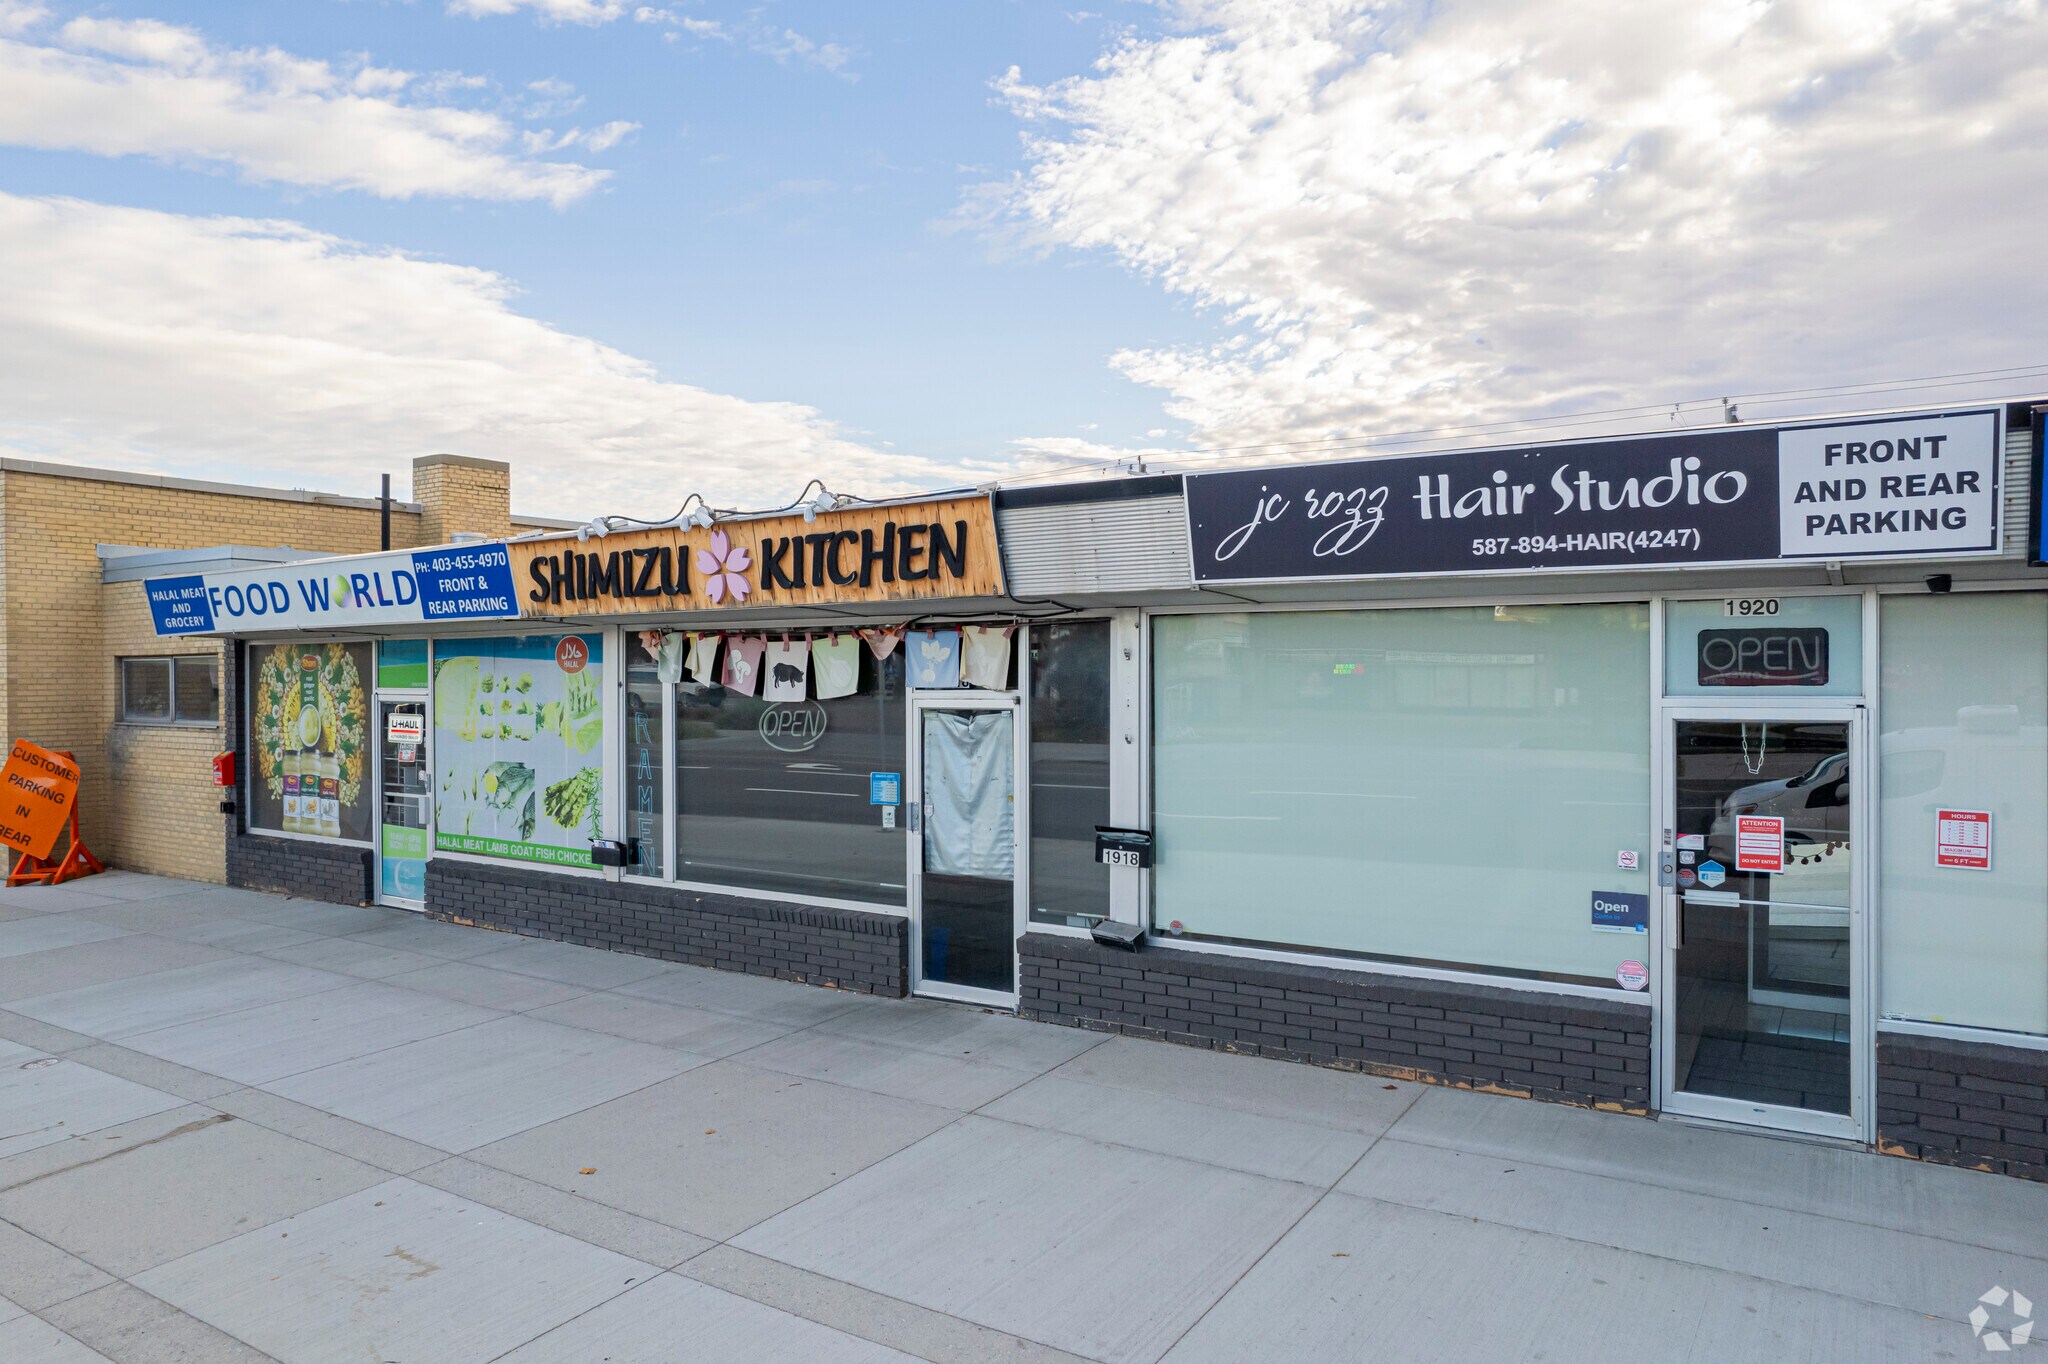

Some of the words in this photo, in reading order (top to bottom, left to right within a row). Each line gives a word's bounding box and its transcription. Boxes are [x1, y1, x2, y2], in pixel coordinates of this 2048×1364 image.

[1825, 435, 1947, 467] FRONT
[1413, 470, 1536, 519] Hair
[1551, 456, 1747, 515] Studio
[1794, 478, 1867, 504] AND
[1880, 471, 1981, 499] REAR
[1806, 506, 1967, 537] PARKING
[1472, 528, 1701, 555] 587-894-HAIR(4247)
[415, 561, 430, 573] PH:
[432, 551, 507, 572] 403-455-4970
[529, 545, 691, 603] SHIMIZU
[760, 520, 968, 590] KITCHEN
[152, 589, 179, 601] HALAL
[181, 587, 204, 599] MEAT
[438, 576, 474, 593] FRONT
[479, 575, 489, 590] &
[172, 603, 191, 614] AND
[208, 581, 290, 617] FOOD
[428, 600, 457, 615] REAR
[459, 597, 508, 613] PARKING
[1726, 599, 1779, 615] 1920
[165, 616, 204, 628] GROCERY
[1702, 636, 1820, 671] OPEN
[763, 710, 820, 737] OPEN
[12, 747, 79, 785] CUSTOMER
[8, 773, 65, 804] PARKING
[634, 711, 656, 876] RAMEN
[15, 804, 31, 818] IN
[436, 836, 462, 849] HALAL
[463, 839, 485, 850] MEAT
[486, 841, 508, 854] LAMB
[510, 844, 534, 857] GOAT
[536, 848, 556, 860] FISH
[557, 850, 594, 865] CHICKE
[1105, 850, 1138, 866] 1918
[1594, 900, 1629, 913] Open
